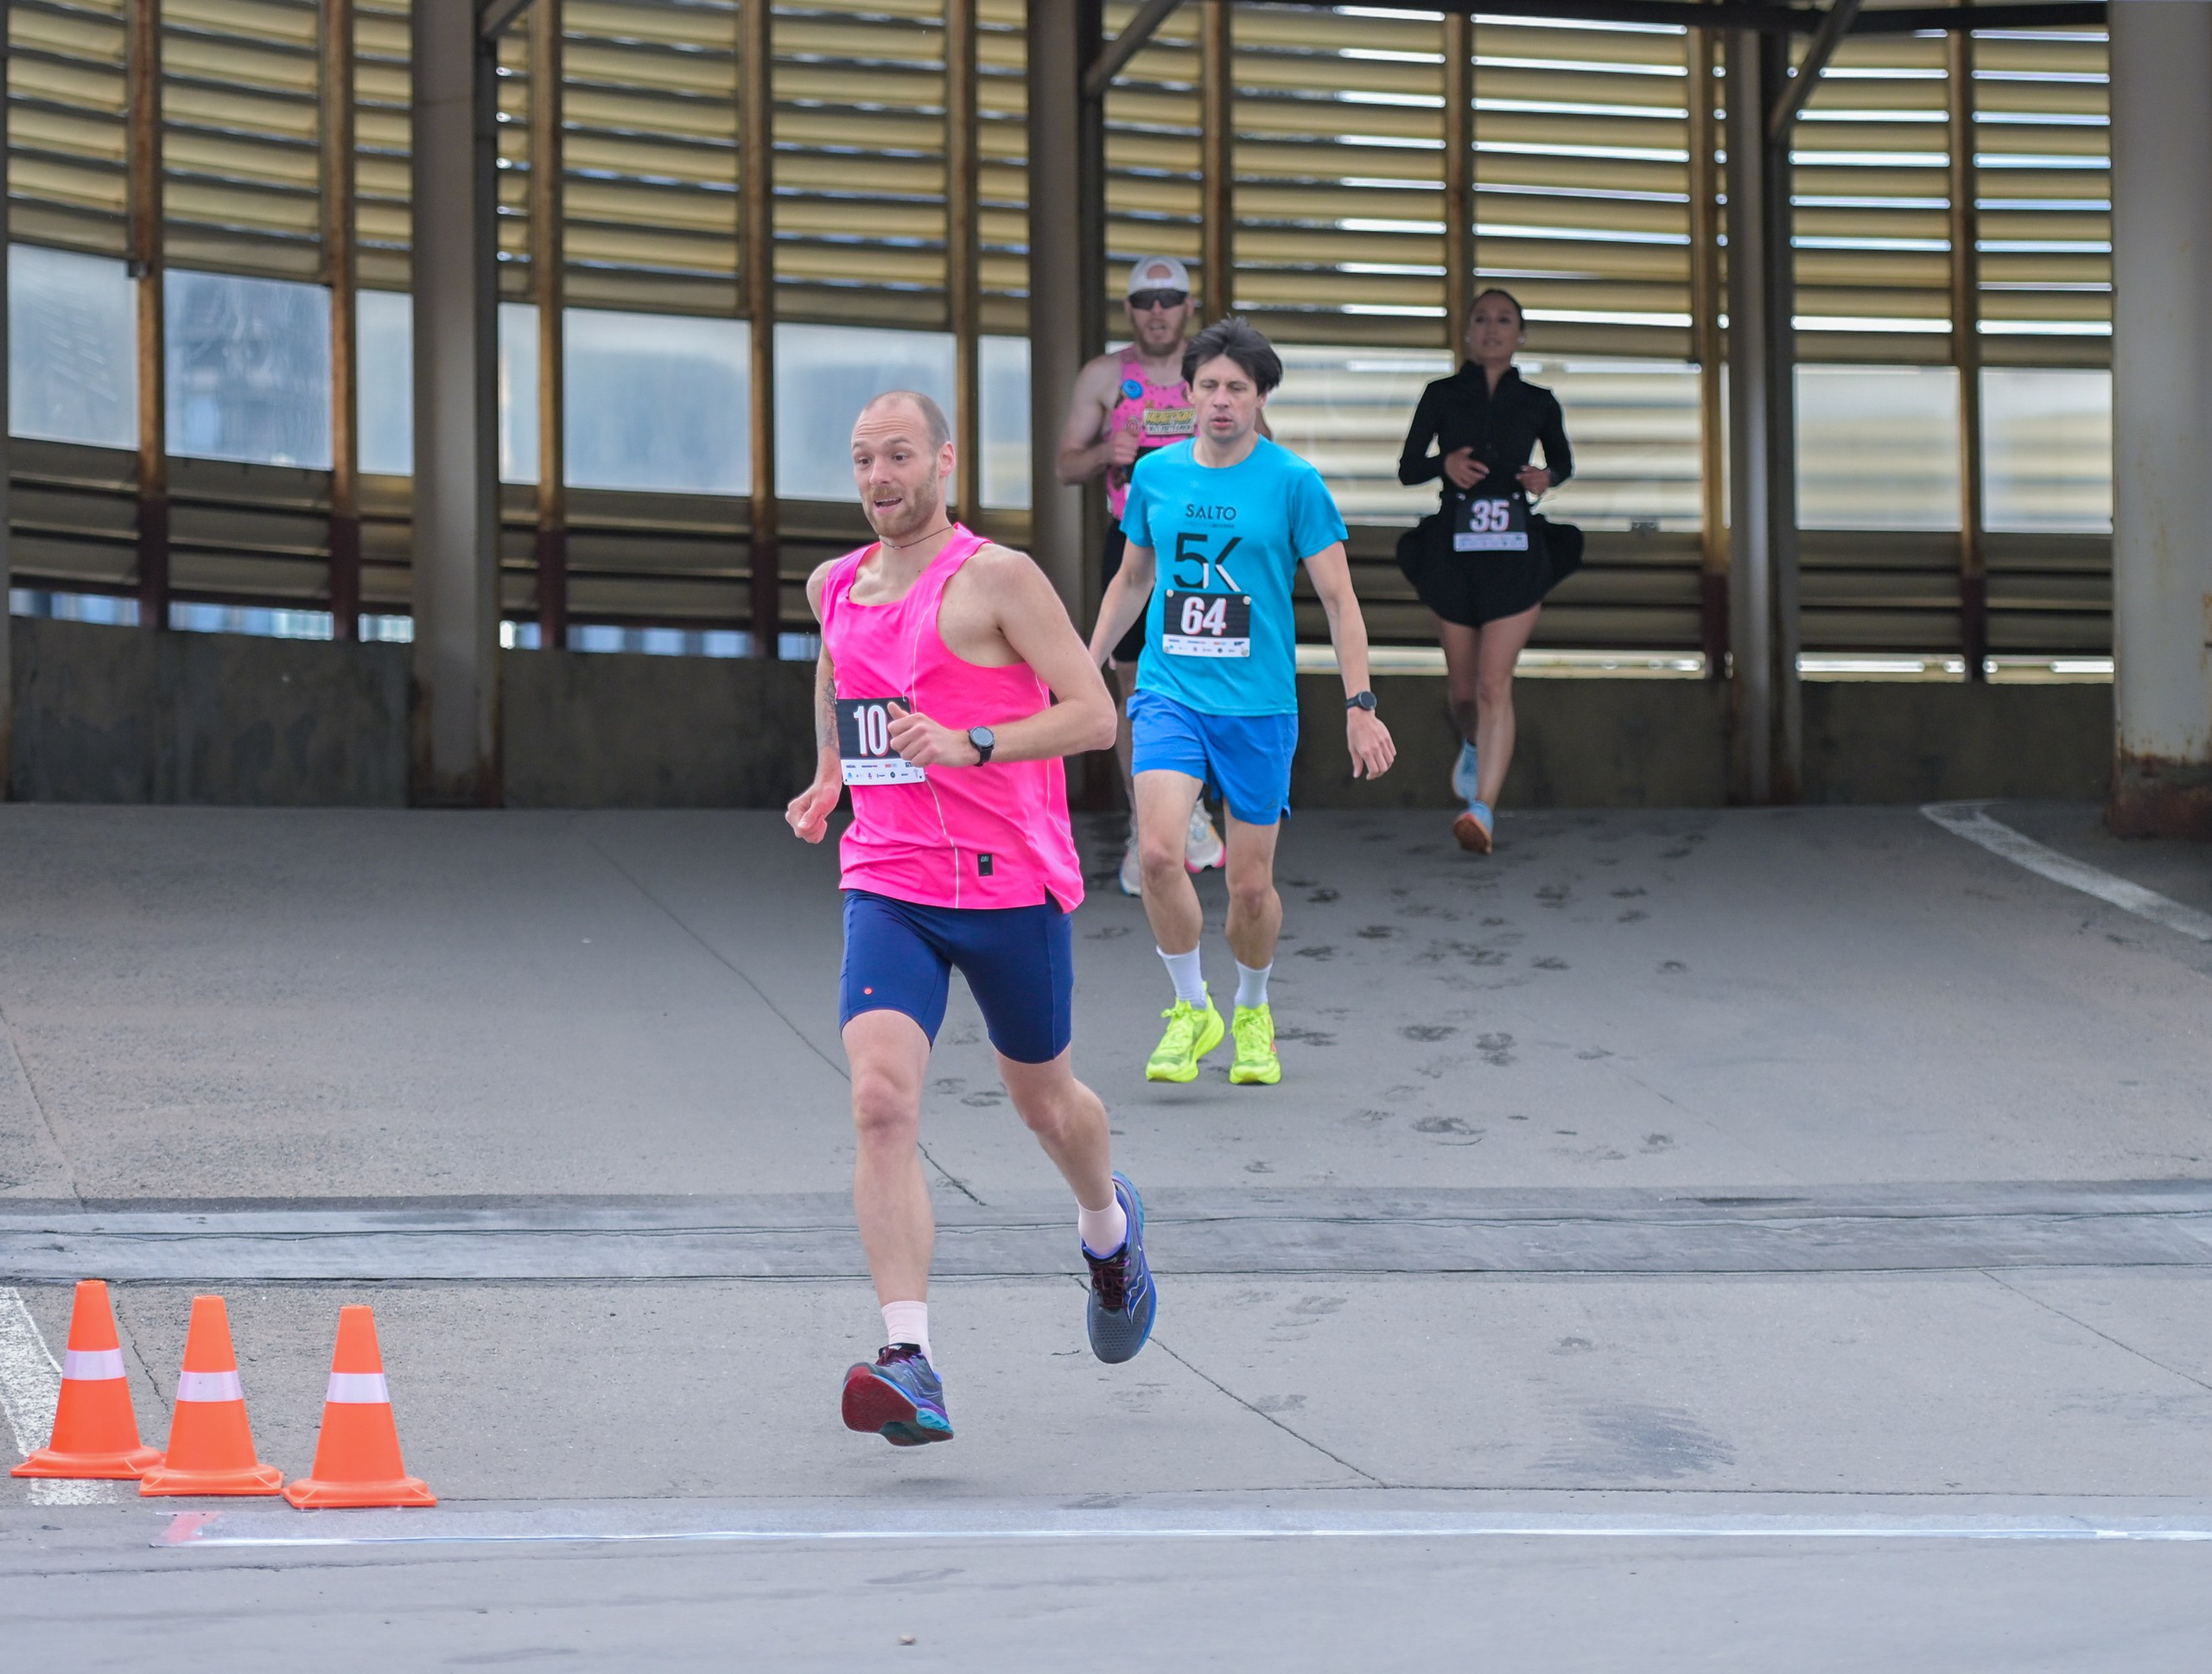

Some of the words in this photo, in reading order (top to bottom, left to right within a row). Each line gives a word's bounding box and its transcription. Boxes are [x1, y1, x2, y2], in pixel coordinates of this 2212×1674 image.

[1185, 504, 1237, 520] SALTO
[1470, 500, 1510, 532] 35
[1173, 532, 1243, 592] 5K
[1180, 595, 1227, 636] 64
[853, 704, 889, 757] 10
